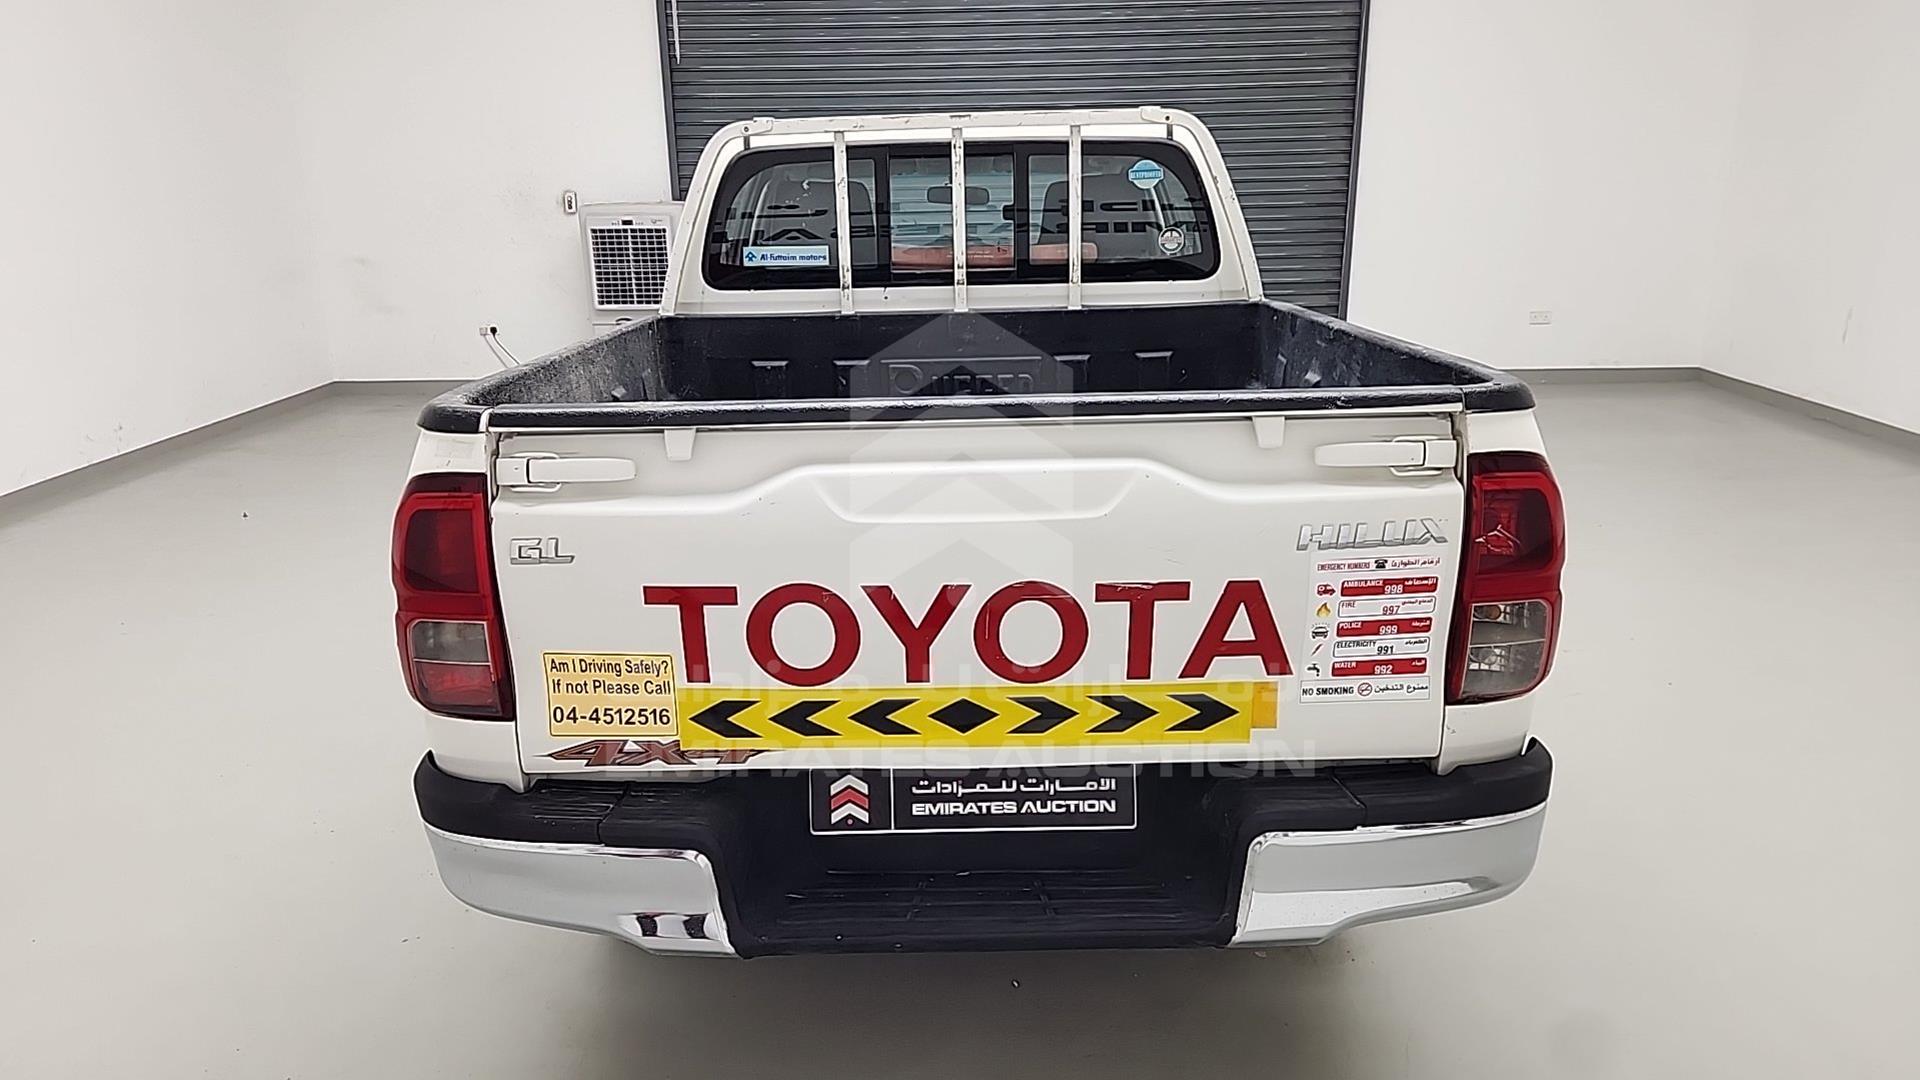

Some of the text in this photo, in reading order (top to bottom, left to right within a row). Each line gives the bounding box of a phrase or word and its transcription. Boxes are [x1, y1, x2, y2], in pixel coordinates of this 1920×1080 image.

[1296, 518, 1448, 551] HILUX
[510, 537, 575, 565] GL
[1317, 561, 1370, 571] EMERGENCY NUMBERS
[1343, 579, 1384, 588] AMBULANCE
[1384, 585, 1403, 594] 998
[1382, 605, 1401, 615] 997
[641, 580, 1293, 686] TOYOTA
[1379, 625, 1398, 635] 999
[1336, 640, 1377, 649] ELECTRICITY
[1377, 645, 1394, 655] 991
[550, 658, 669, 677] Am I Driving Safely?
[1374, 665, 1393, 675] 992
[552, 679, 671, 695] If not Please Call
[1302, 686, 1355, 697] NO SMOKING
[1406, 684, 1429, 694] ممنوع
[552, 706, 671, 726] 04-4512516
[912, 778, 1116, 797] الامارات للمزادات
[912, 800, 1116, 815] EMIRATES AUCTION
